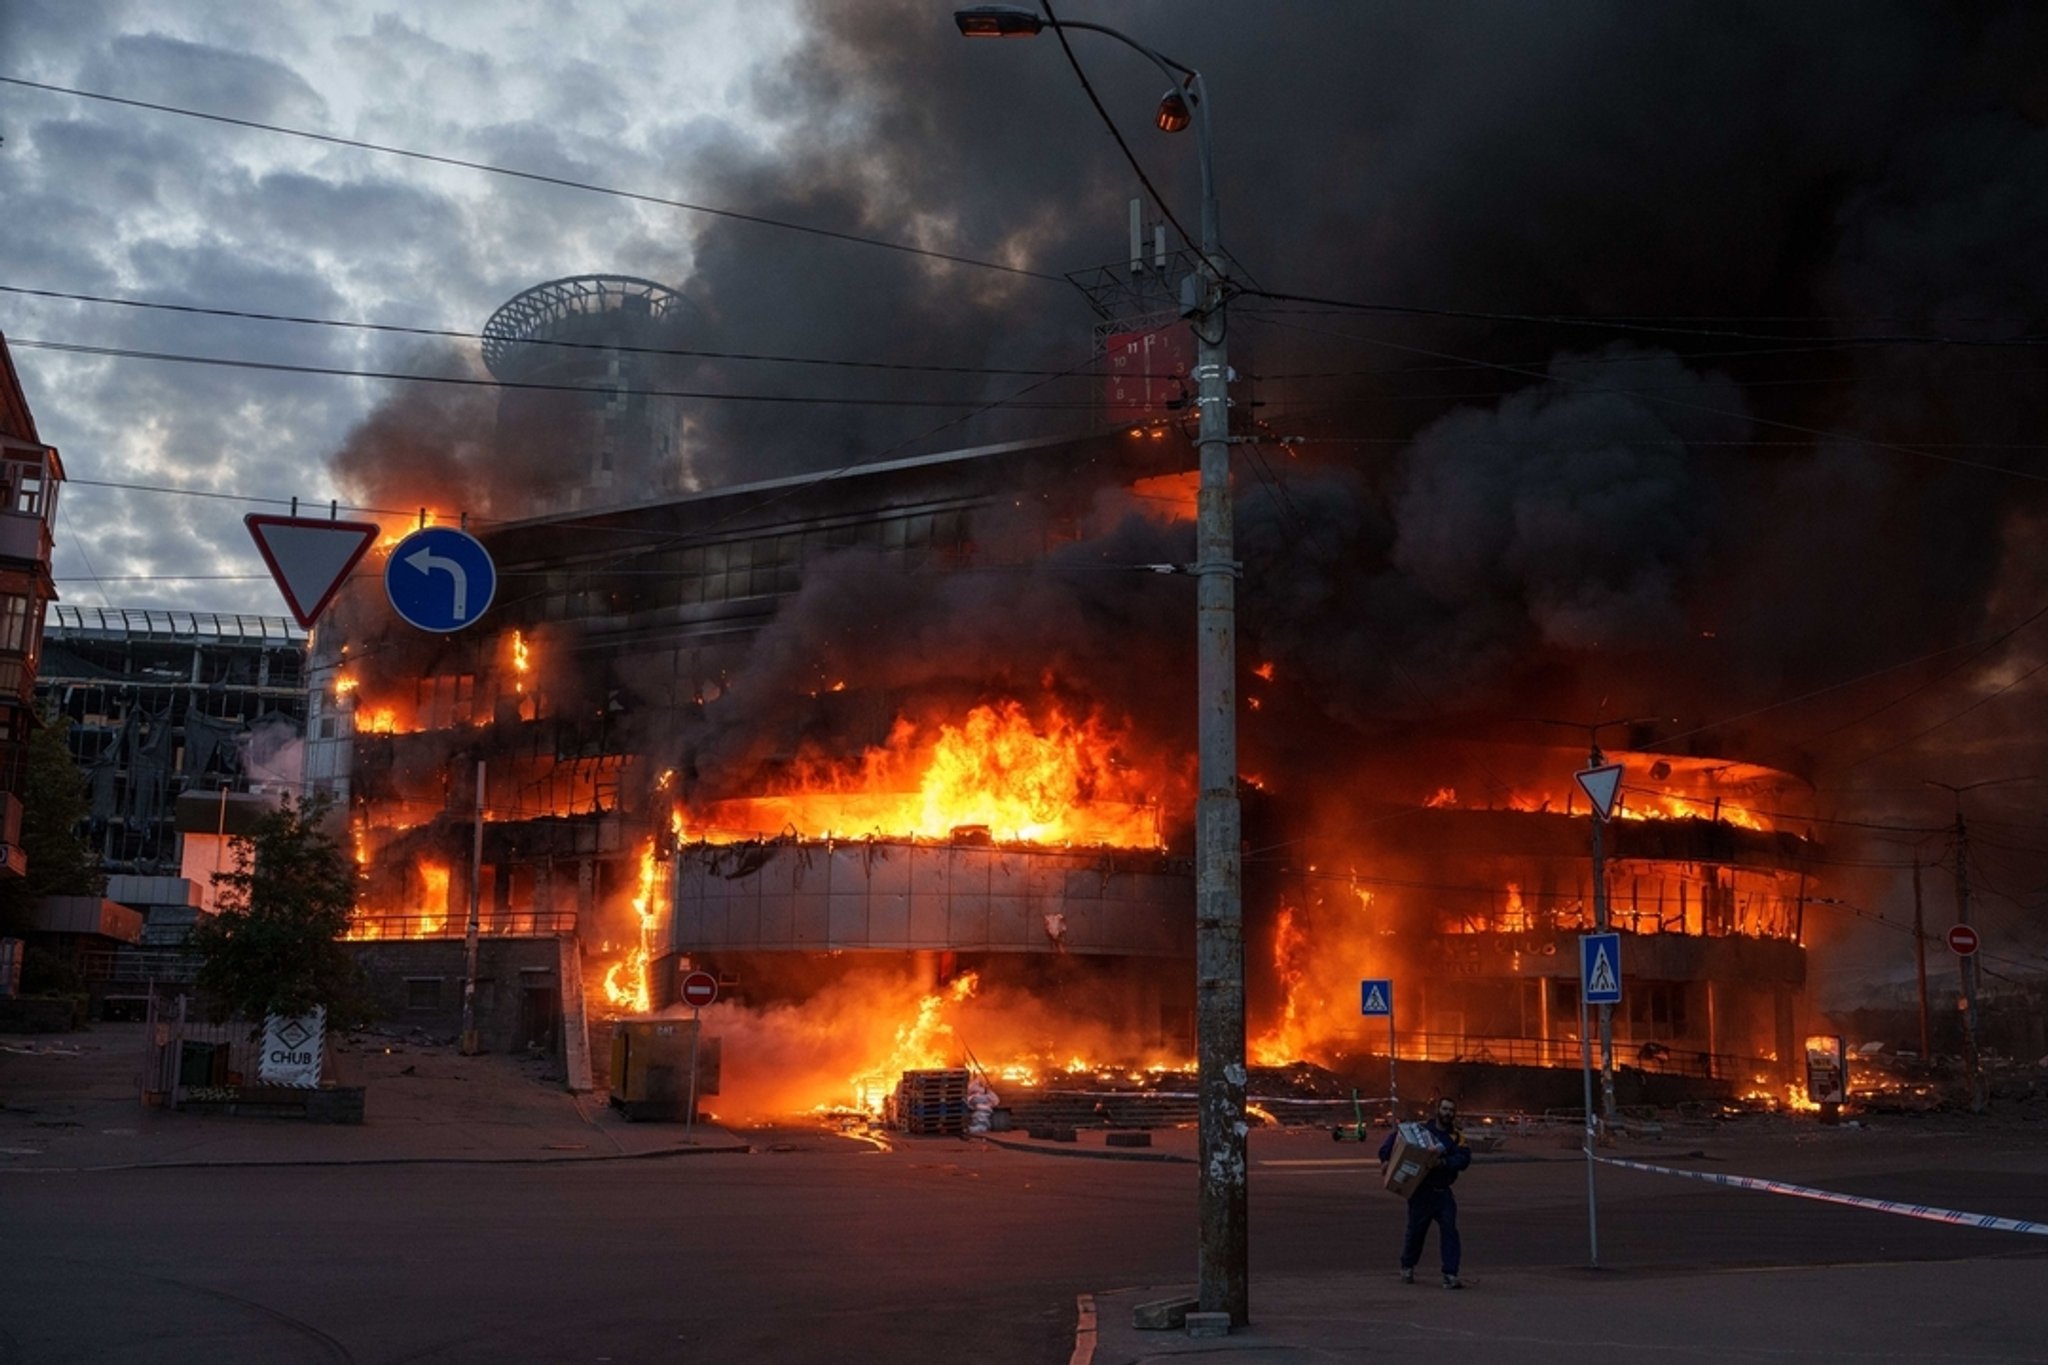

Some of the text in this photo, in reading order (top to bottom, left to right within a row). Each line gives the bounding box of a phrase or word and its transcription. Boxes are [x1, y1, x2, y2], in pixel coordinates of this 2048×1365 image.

[1144, 334, 1156, 345] 12
[1127, 342, 1138, 354] 11
[1114, 356, 1127, 367] 10
[1176, 362, 1185, 373] 3
[1116, 388, 1125, 400] 8
[270, 1051, 312, 1065] CHUB
